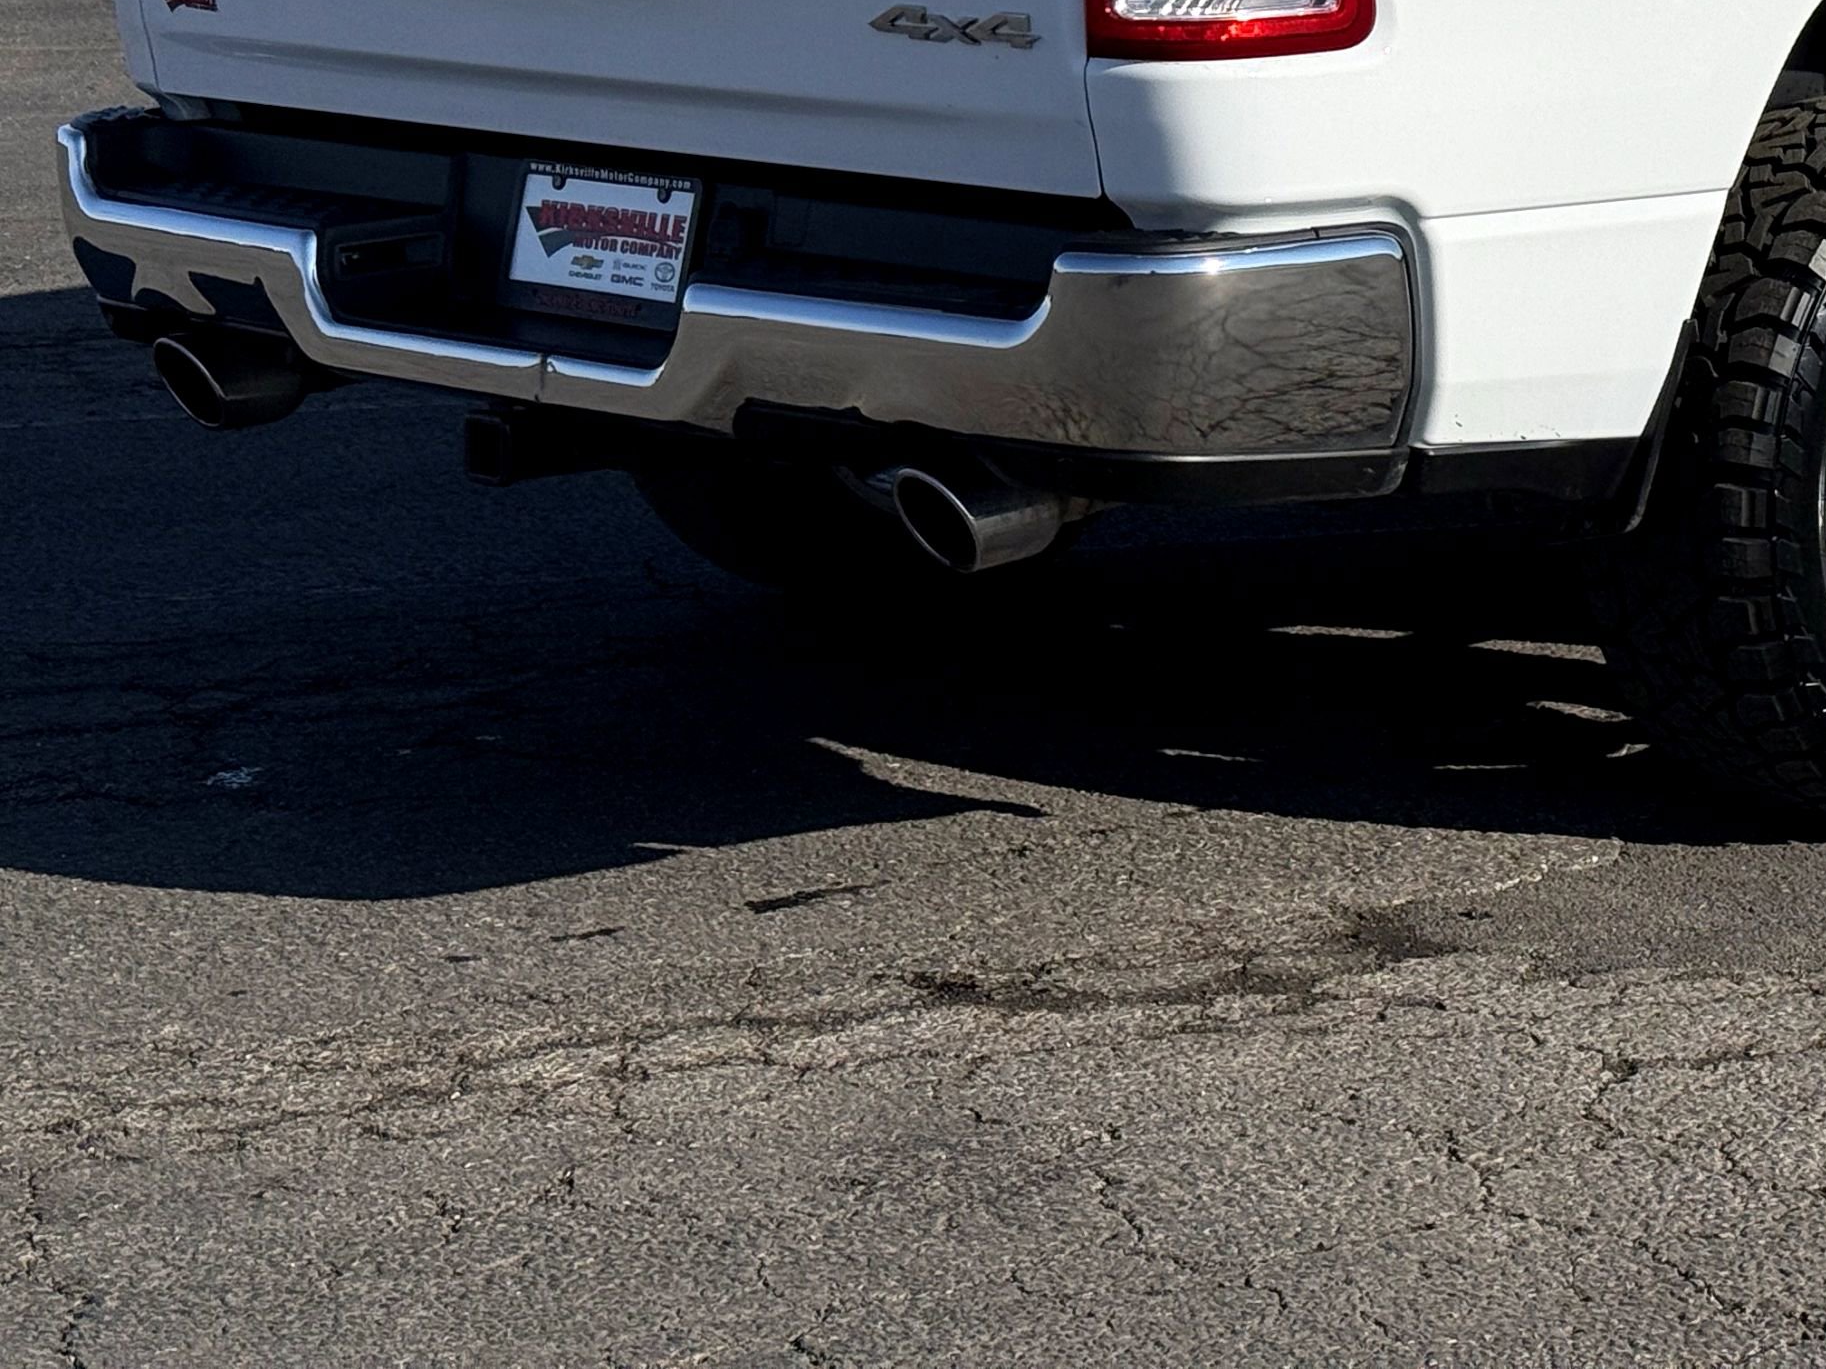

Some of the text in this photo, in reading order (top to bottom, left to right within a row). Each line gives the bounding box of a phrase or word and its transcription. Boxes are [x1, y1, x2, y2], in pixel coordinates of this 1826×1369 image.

[540, 199, 688, 242] KIRKSVILLE
[573, 237, 682, 261] MOTOR COMPANY
[610, 273, 645, 287] GMC
